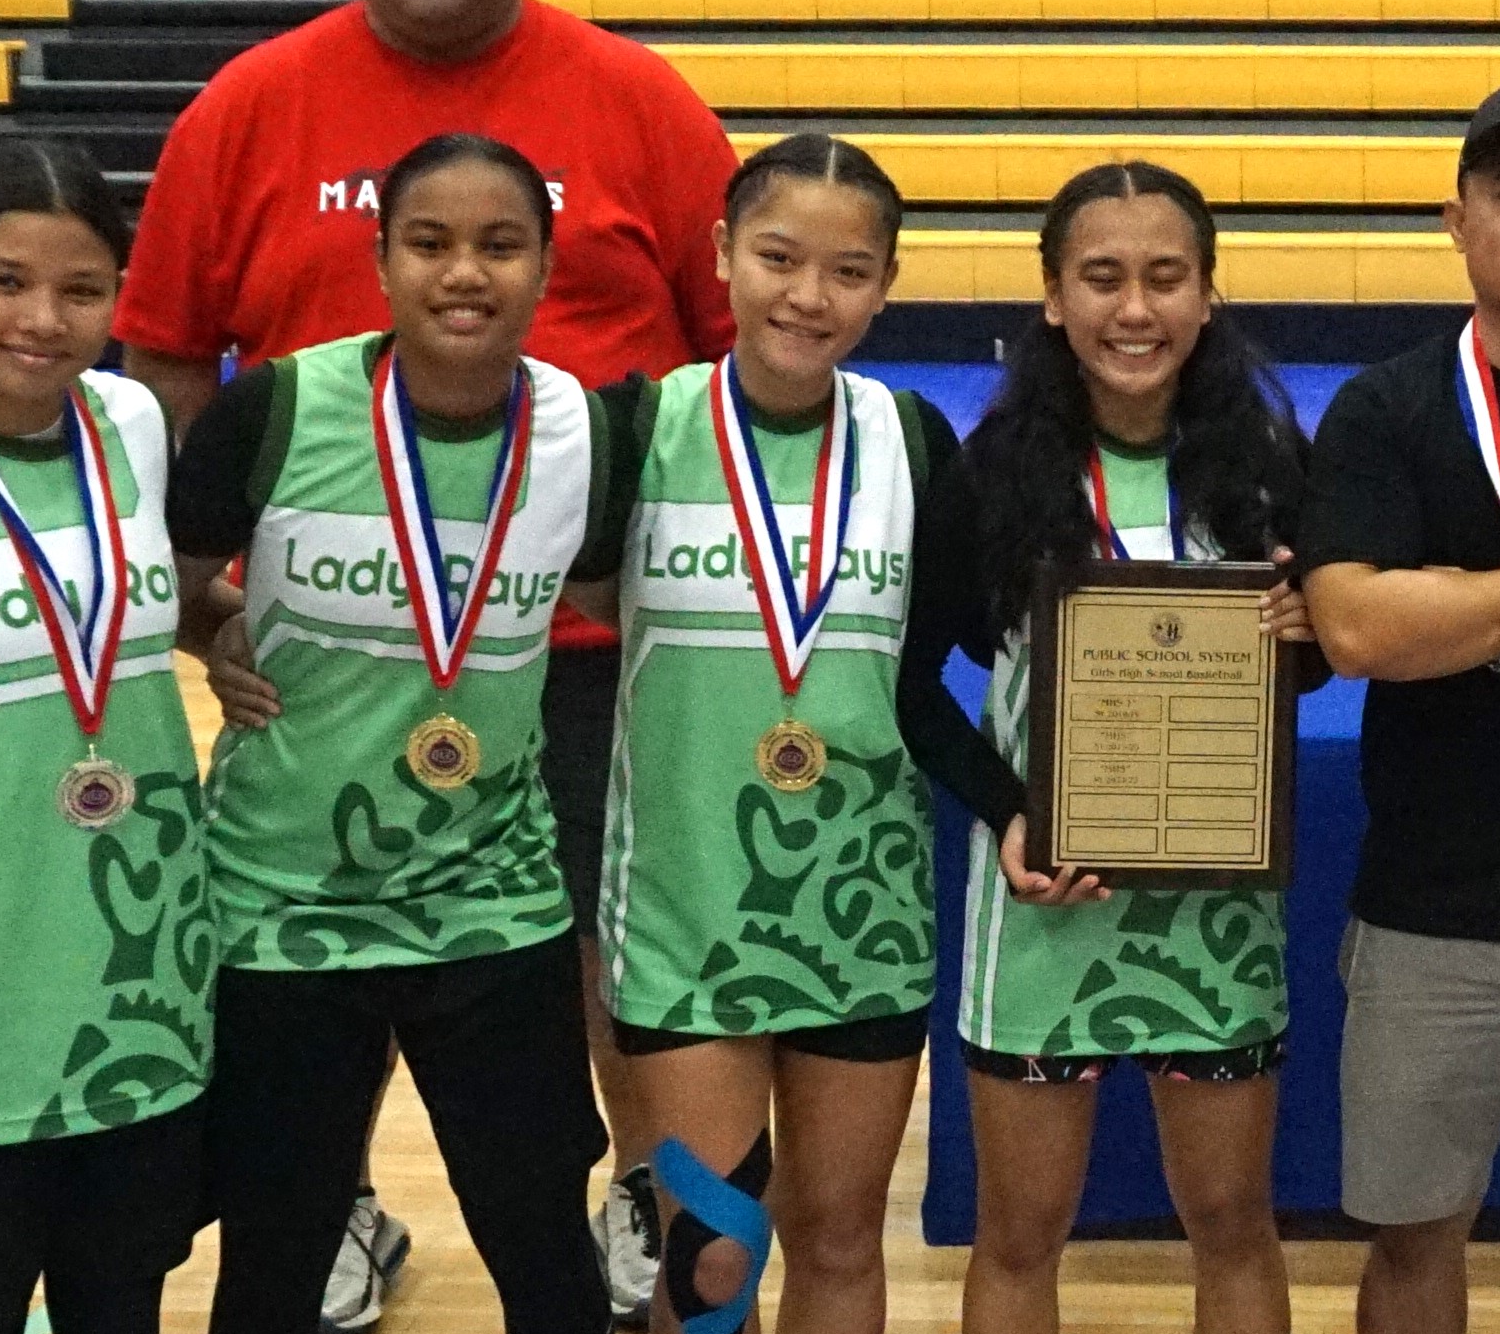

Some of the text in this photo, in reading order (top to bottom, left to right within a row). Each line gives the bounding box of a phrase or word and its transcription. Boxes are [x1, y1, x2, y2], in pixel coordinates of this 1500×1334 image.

[1082, 649, 1252, 664] PUBLIC SCHOOL SYSTEM
